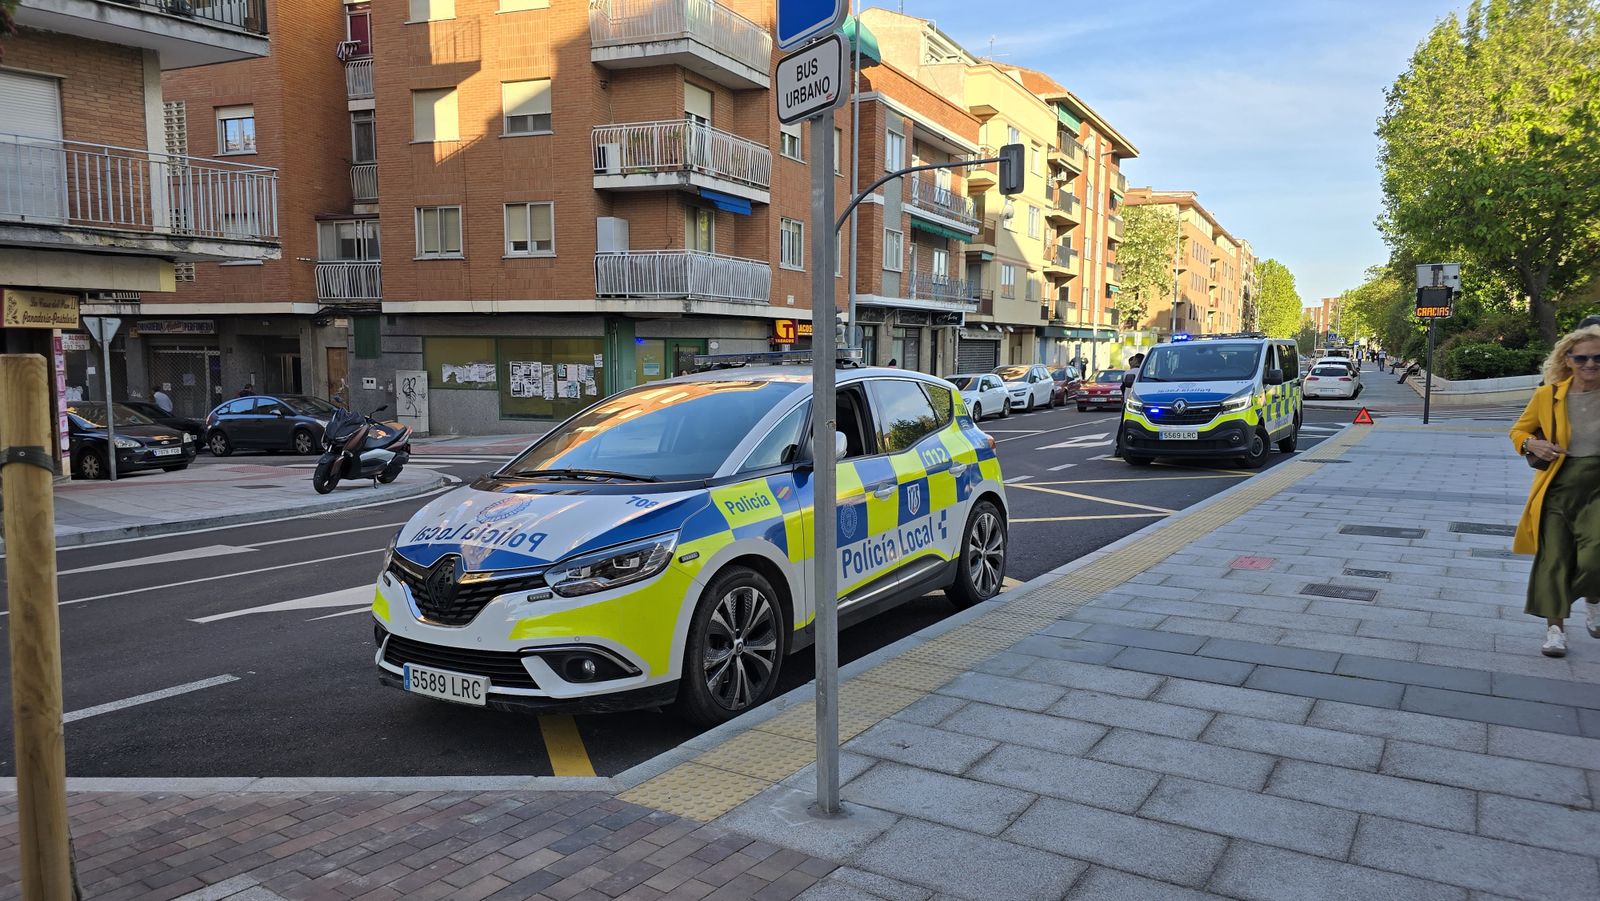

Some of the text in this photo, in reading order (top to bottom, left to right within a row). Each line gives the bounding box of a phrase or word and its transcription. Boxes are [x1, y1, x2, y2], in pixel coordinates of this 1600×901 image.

[796, 57, 818, 82] BUS
[785, 76, 831, 109] URBANO
[1417, 307, 1450, 317] GRACIAS
[1183, 431, 1196, 439] LRC
[625, 496, 660, 509] 708
[724, 492, 771, 515] Policía
[841, 516, 934, 579] Policía Local
[412, 669, 481, 700] 5589 LRC
